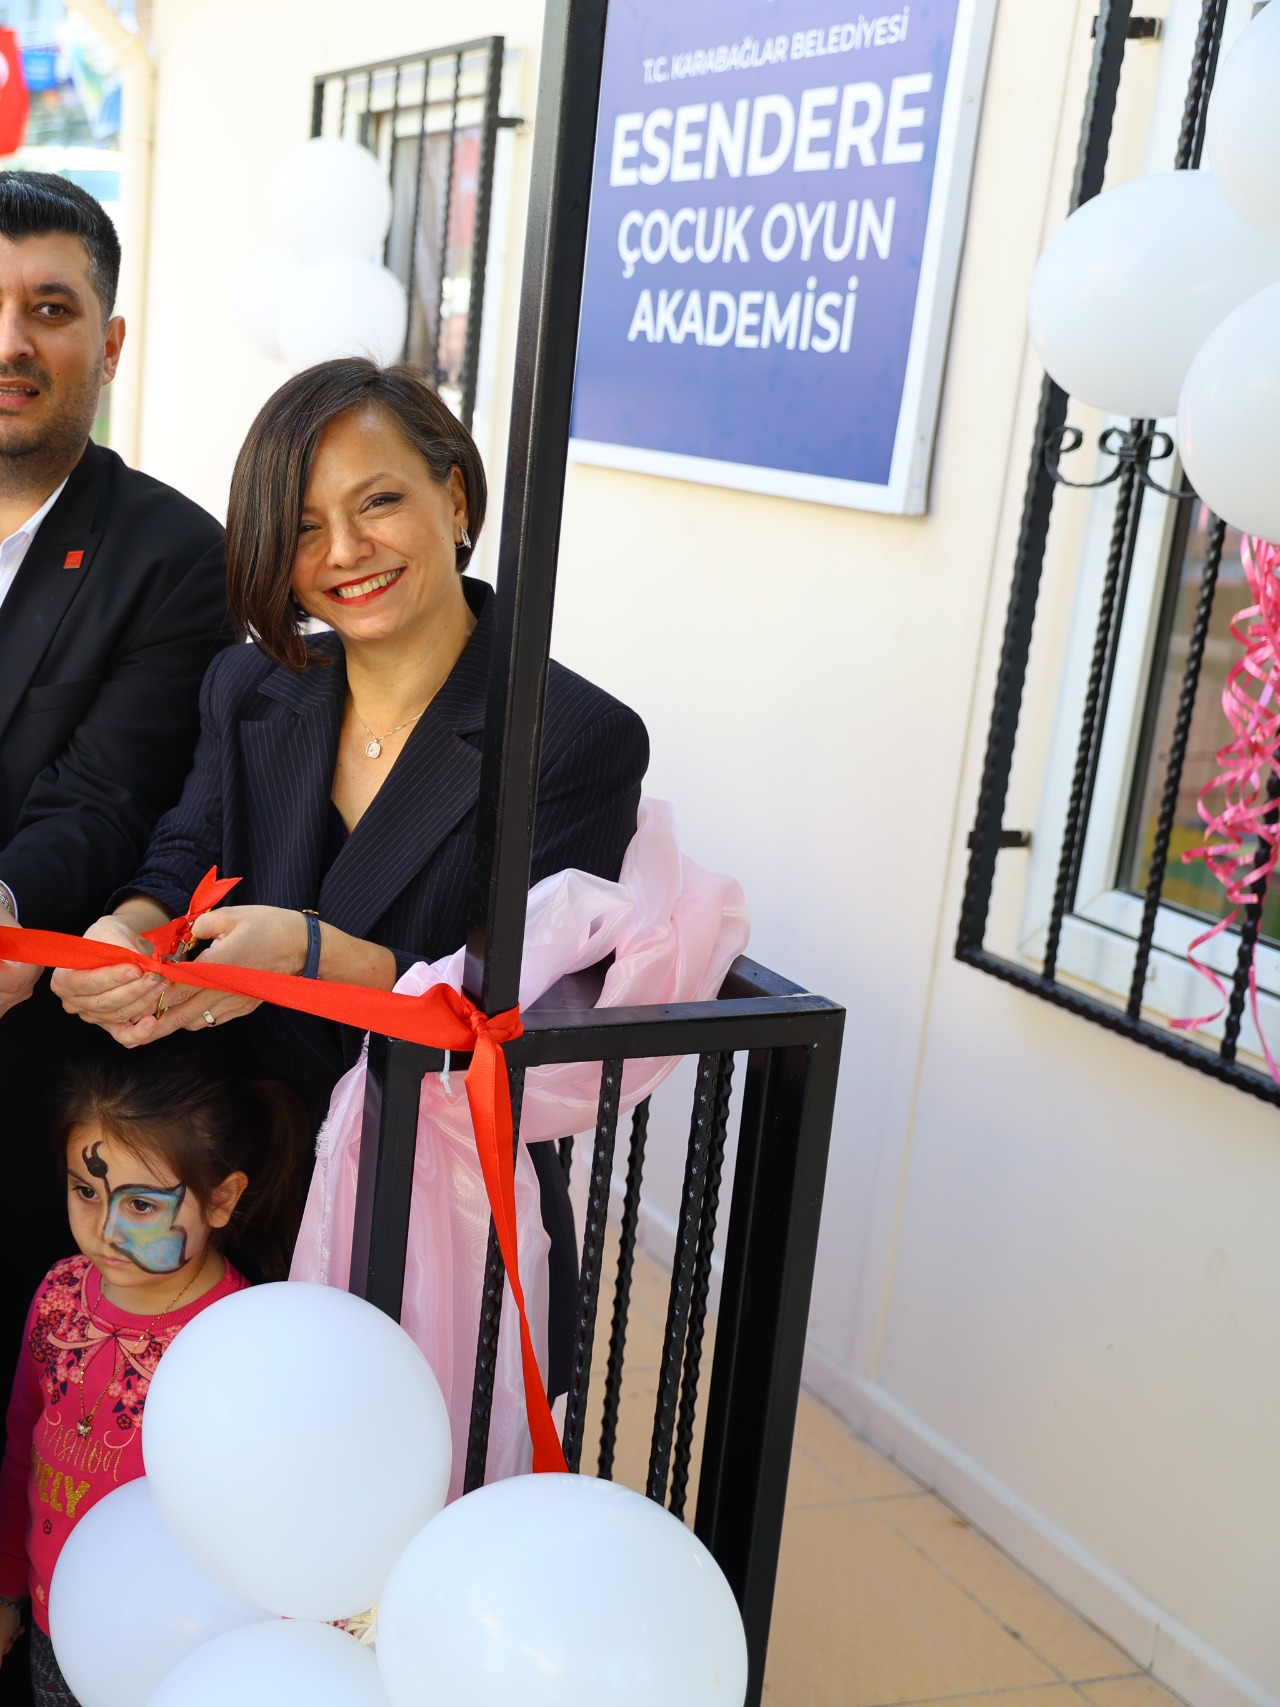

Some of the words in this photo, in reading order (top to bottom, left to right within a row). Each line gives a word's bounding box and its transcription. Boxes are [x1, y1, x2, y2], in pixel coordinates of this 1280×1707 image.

[642, 56, 669, 85] T.C.
[671, 35, 788, 80] KARABAĞLAR
[791, 4, 910, 61] BELEDİYESİ
[609, 72, 933, 187] ESENDERE
[617, 204, 755, 279] ÇOCUK
[760, 197, 897, 263] OYUN
[627, 275, 859, 353] AKADEMİSİ
